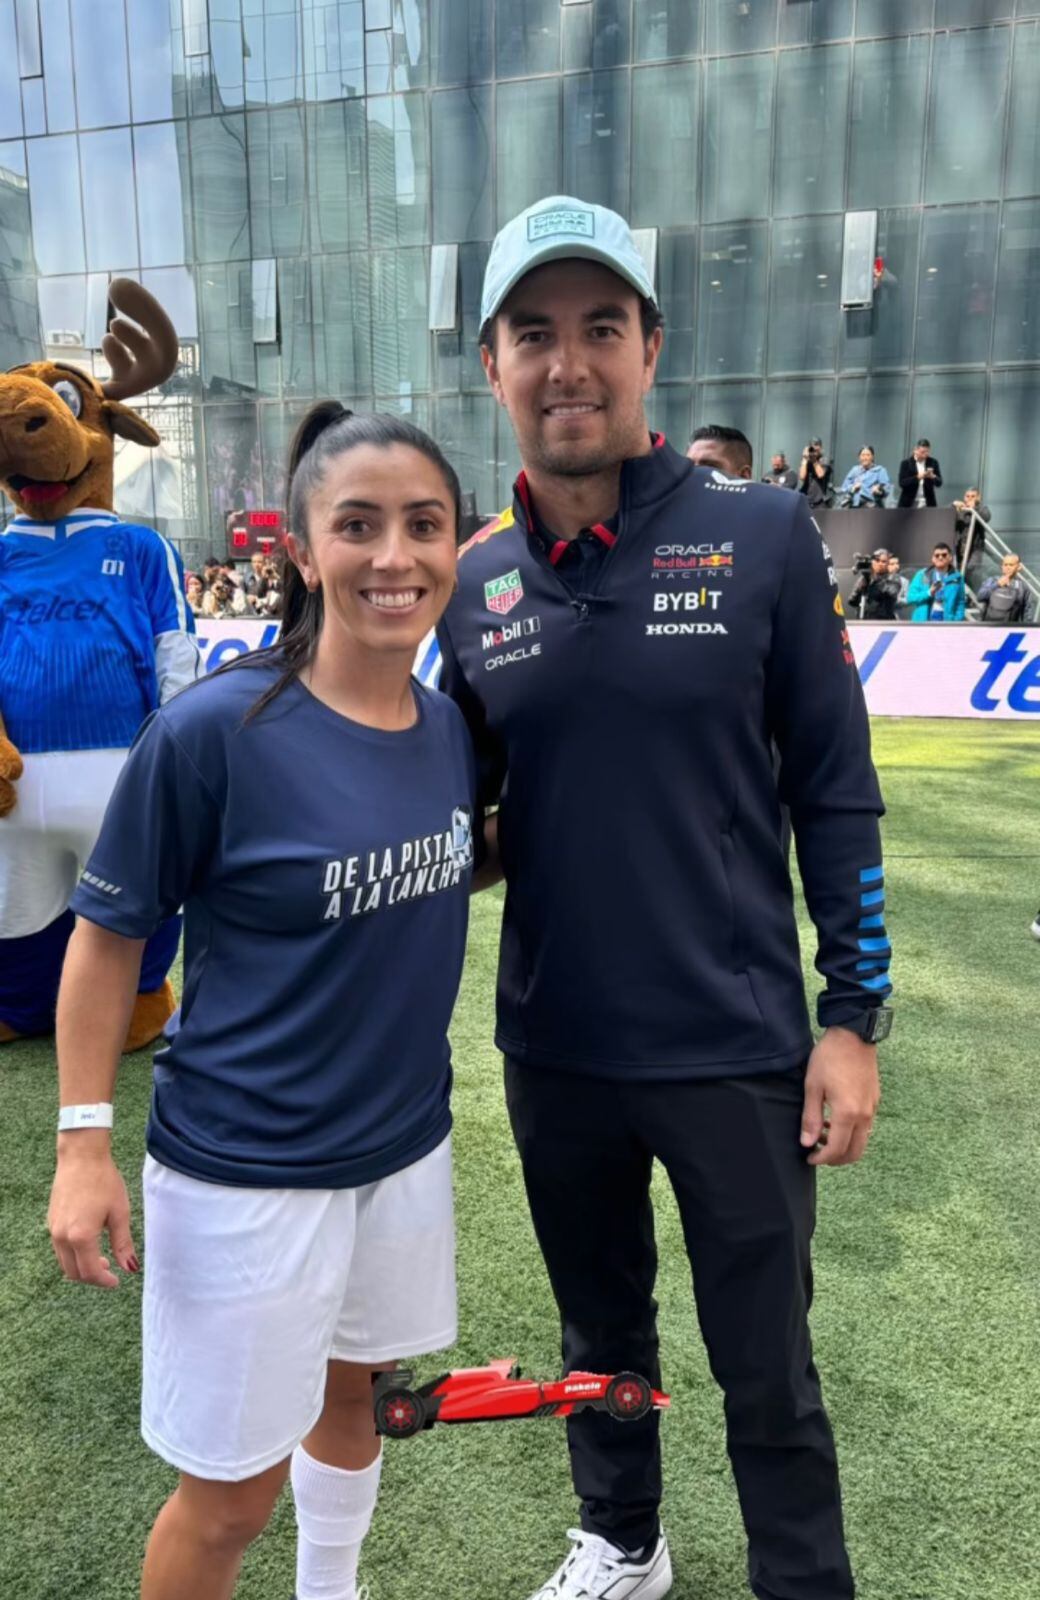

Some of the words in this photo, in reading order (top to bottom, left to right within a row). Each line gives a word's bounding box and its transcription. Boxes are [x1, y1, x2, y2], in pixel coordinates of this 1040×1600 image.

[655, 541, 734, 556] ORACLE
[653, 557, 674, 568] Red
[676, 556, 697, 568] Bull
[487, 573, 519, 595] TAG
[651, 570, 733, 579] RACING
[653, 587, 723, 612] BYBIT
[482, 620, 521, 650] Mobil
[645, 623, 729, 636] HONDA
[485, 643, 542, 671] ORACLE
[323, 856, 359, 892] DE
[367, 848, 393, 883] LA
[400, 831, 455, 873] PISTA
[324, 891, 342, 920] A
[351, 881, 382, 916] LA
